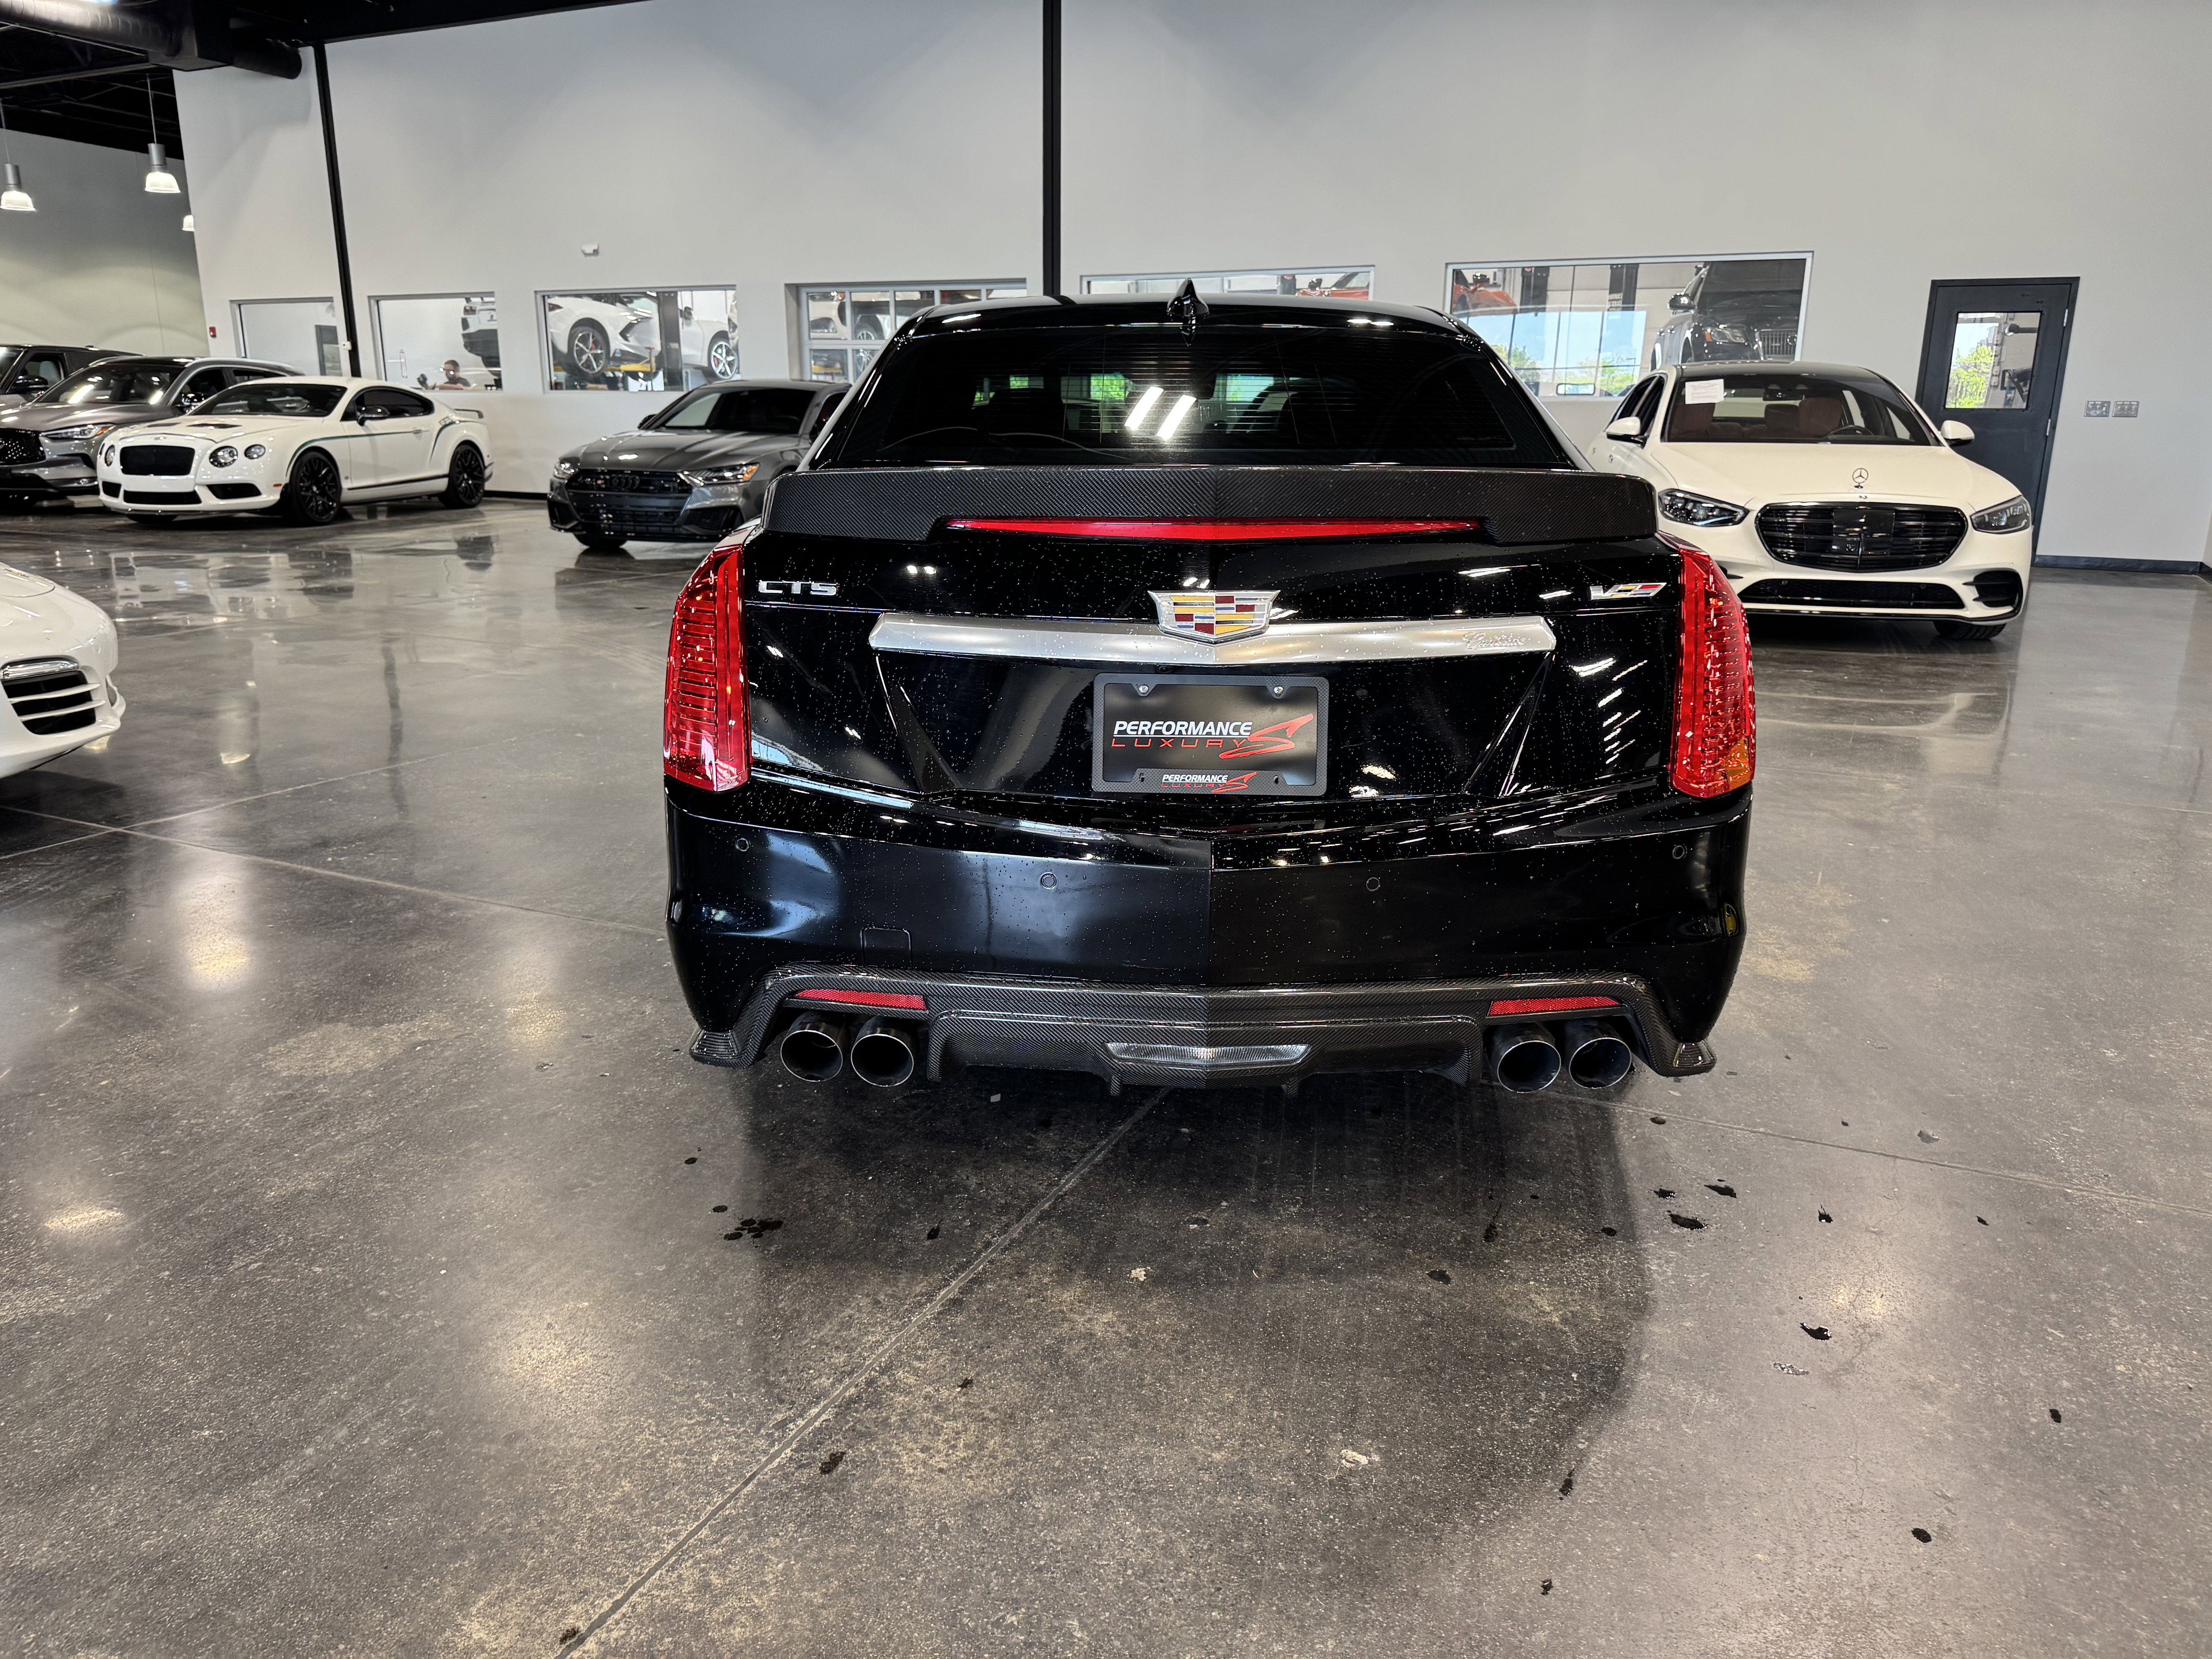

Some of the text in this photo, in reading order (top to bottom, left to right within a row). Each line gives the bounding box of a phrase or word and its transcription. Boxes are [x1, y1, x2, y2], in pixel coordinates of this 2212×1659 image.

[758, 580, 837, 596] CTS
[1113, 721, 1253, 735] PERFORMANCE
[1111, 738, 1246, 747] LUXURY
[1162, 774, 1228, 782] PERFORMANCE
